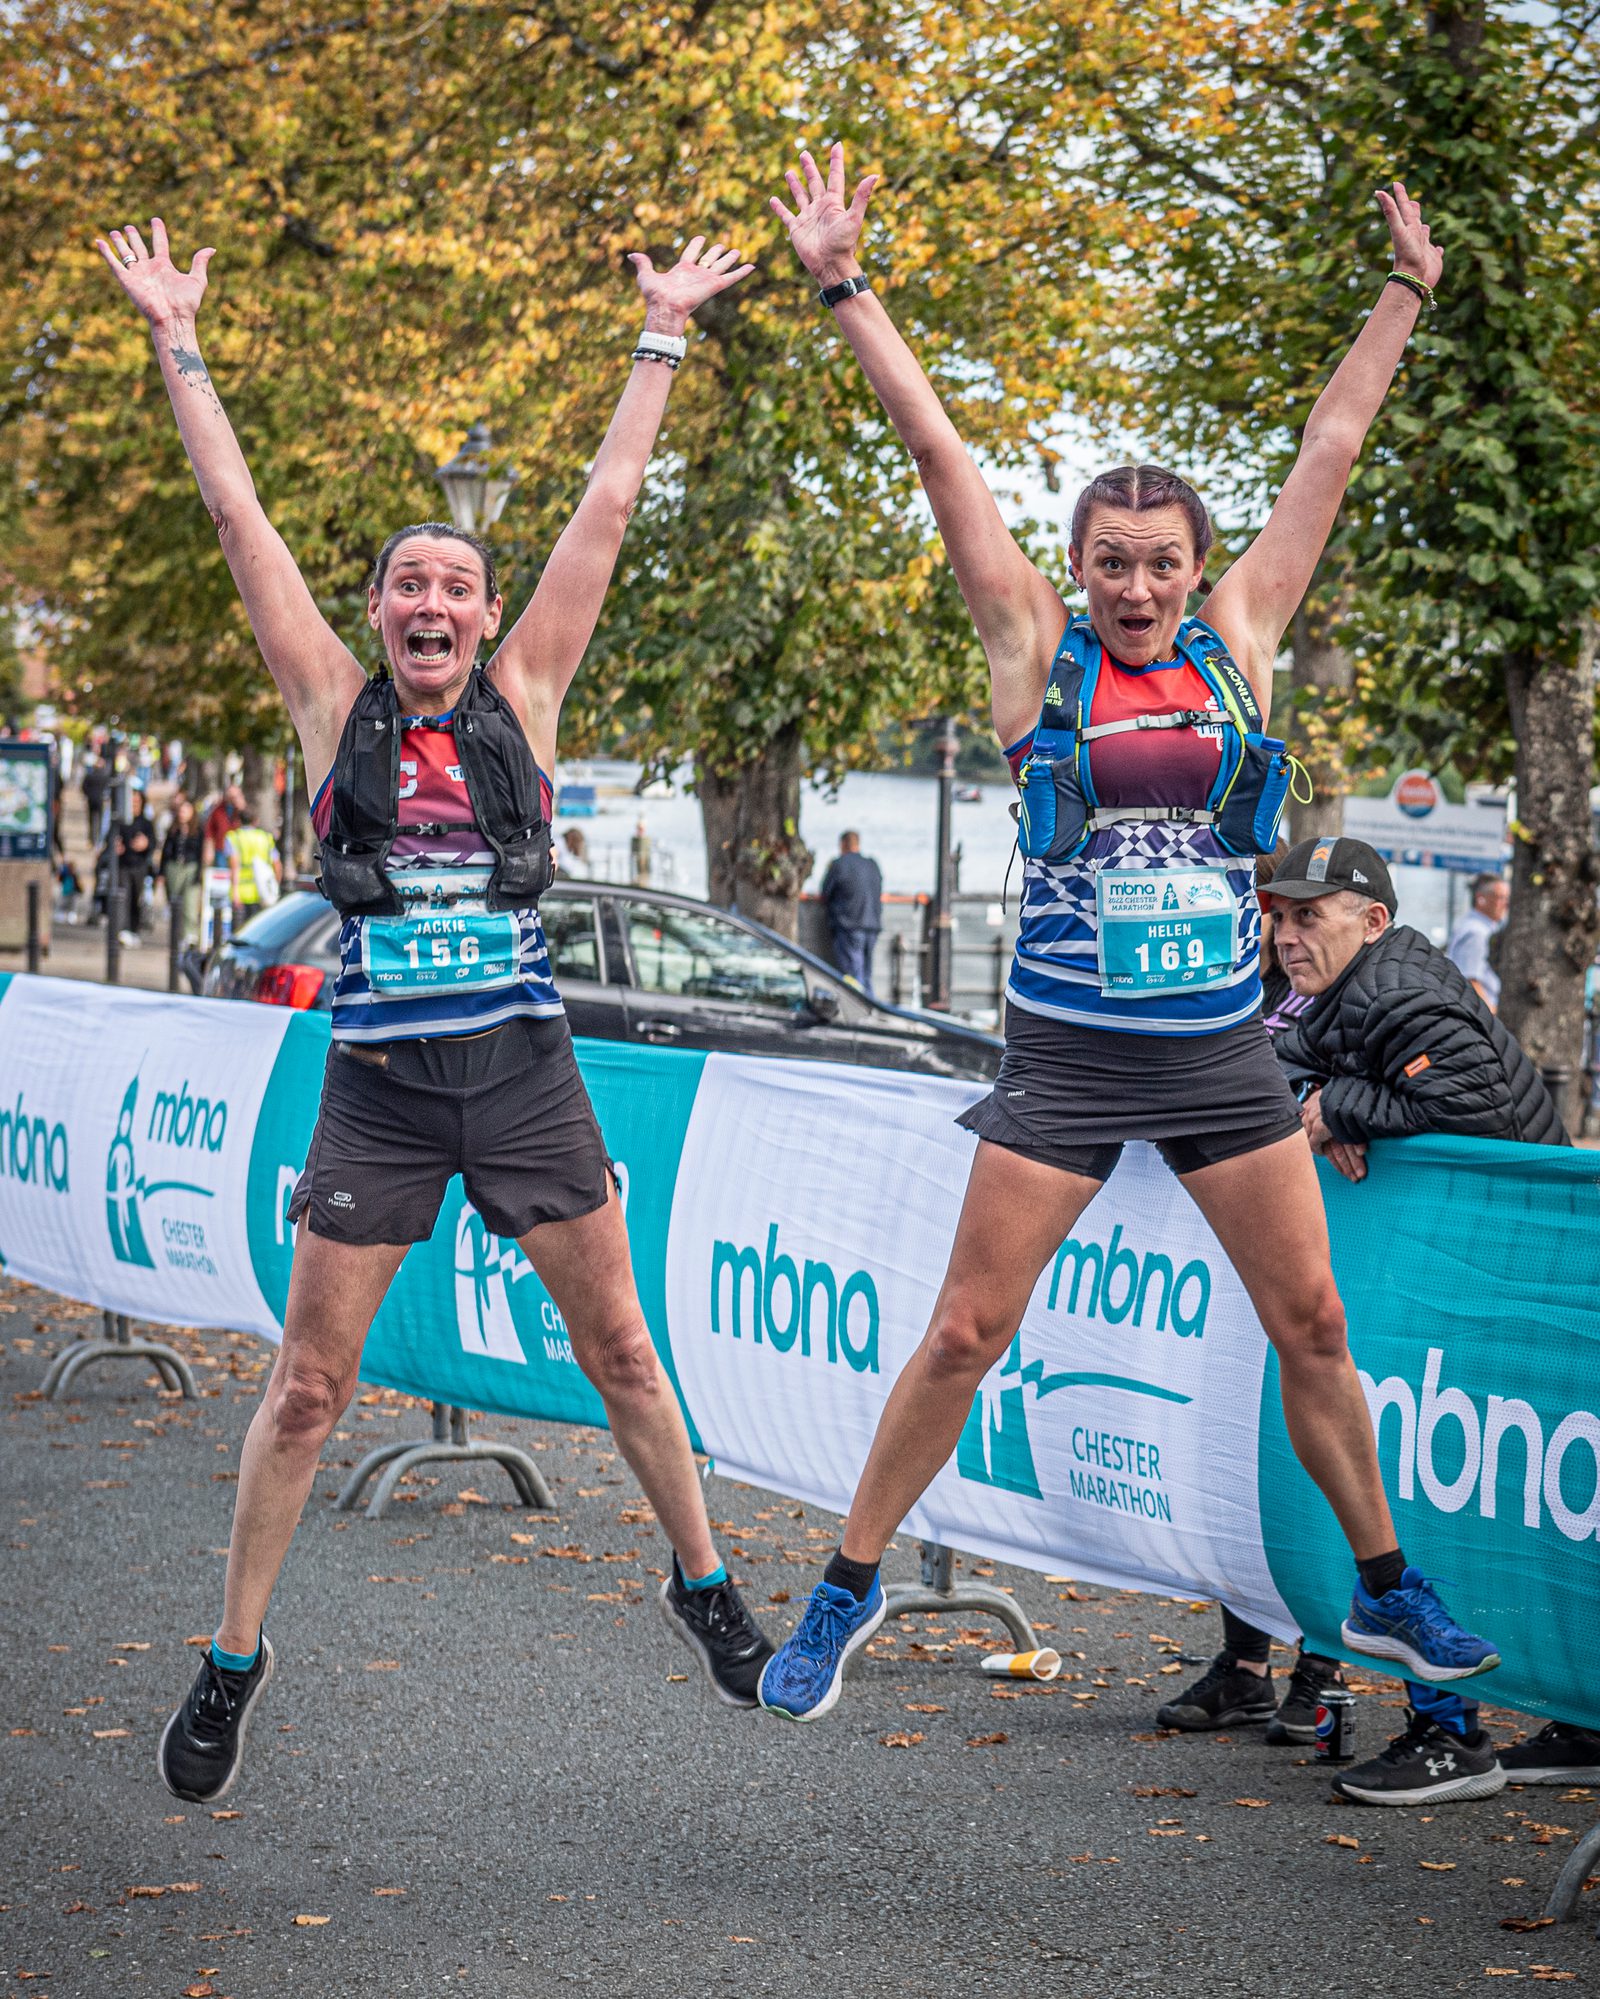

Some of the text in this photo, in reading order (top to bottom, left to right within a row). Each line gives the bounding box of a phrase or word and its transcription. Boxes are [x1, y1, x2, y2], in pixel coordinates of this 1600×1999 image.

[1110, 882, 1155, 895] mbna
[1125, 896, 1158, 904] CHESTER
[413, 919, 466, 934] JACKIE
[1148, 923, 1191, 938] HELEN
[403, 936, 480, 968] 156
[1135, 939, 1204, 972] 169
[148, 1079, 228, 1152] mbna
[162, 1217, 207, 1249] CHESTER
[166, 1249, 219, 1276] MARATHON
[1047, 1224, 1211, 1339] mbna
[711, 1222, 880, 1374] mbna
[1072, 1426, 1162, 1481] CHESTER
[1069, 1469, 1172, 1523] MARATHON
